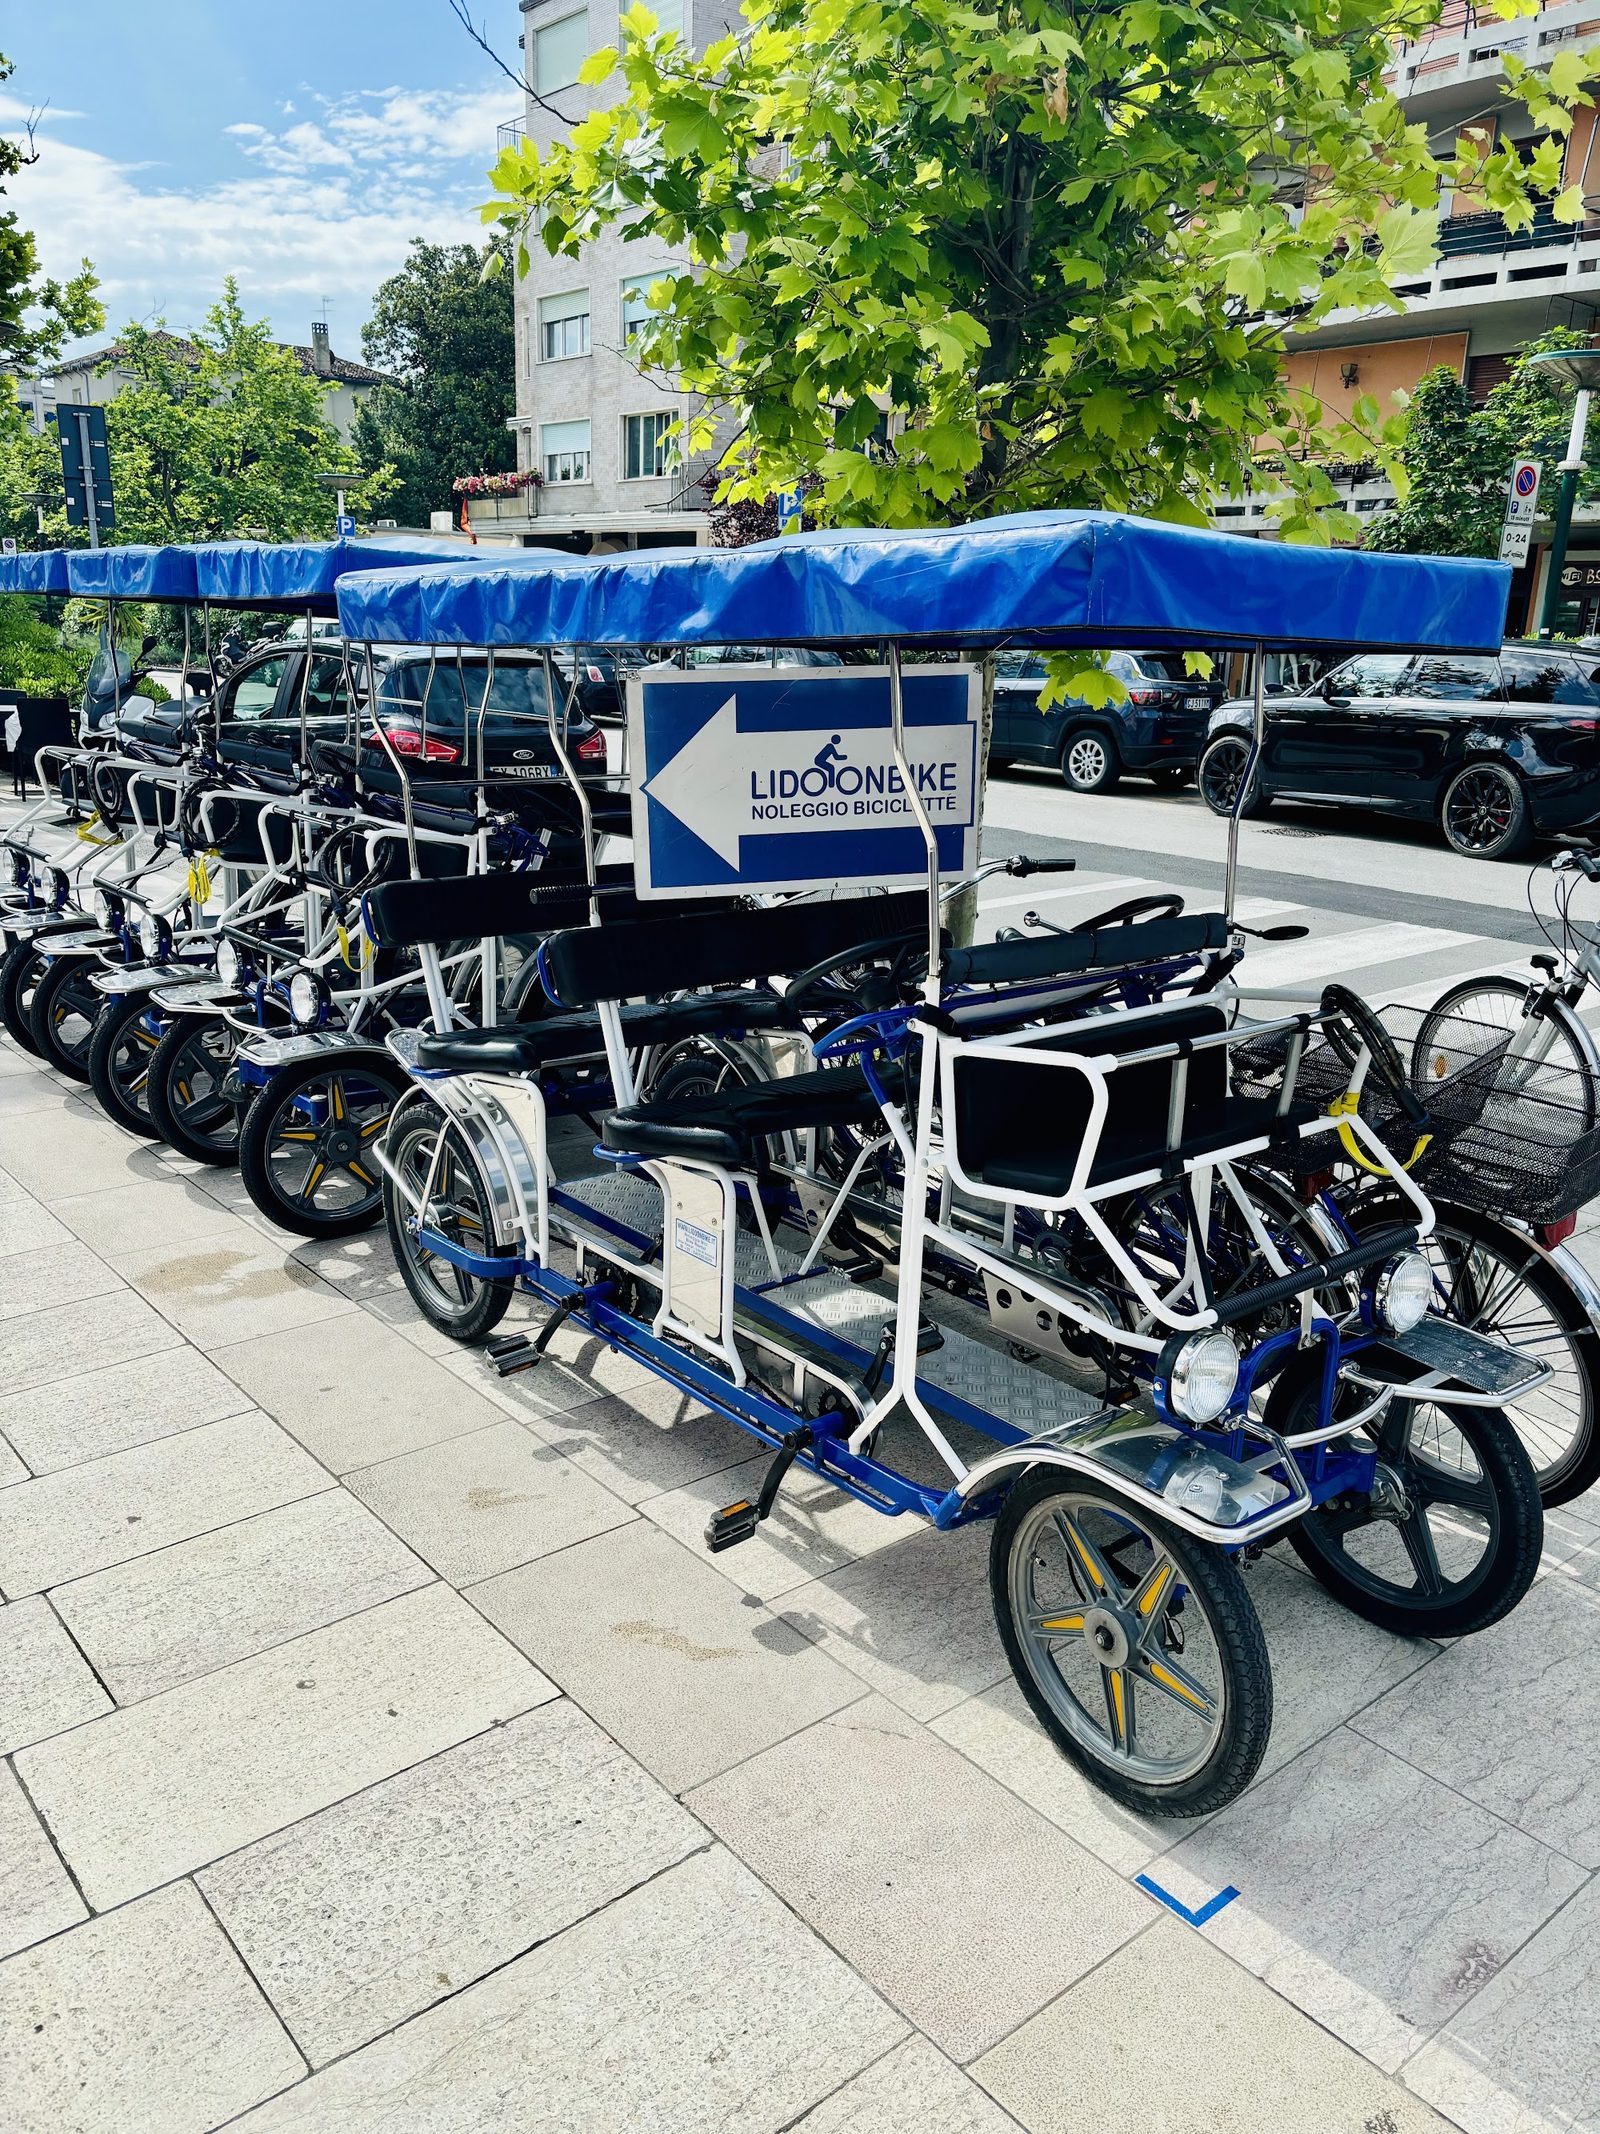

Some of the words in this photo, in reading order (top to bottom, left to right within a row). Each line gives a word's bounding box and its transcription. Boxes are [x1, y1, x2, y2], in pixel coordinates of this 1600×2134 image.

[1511, 502, 1518, 512] P
[341, 518, 352, 534] P
[1506, 533, 1526, 543] 0-24
[752, 802, 848, 820] NOLEGGIO
[853, 797, 957, 815] BICICLTTE
